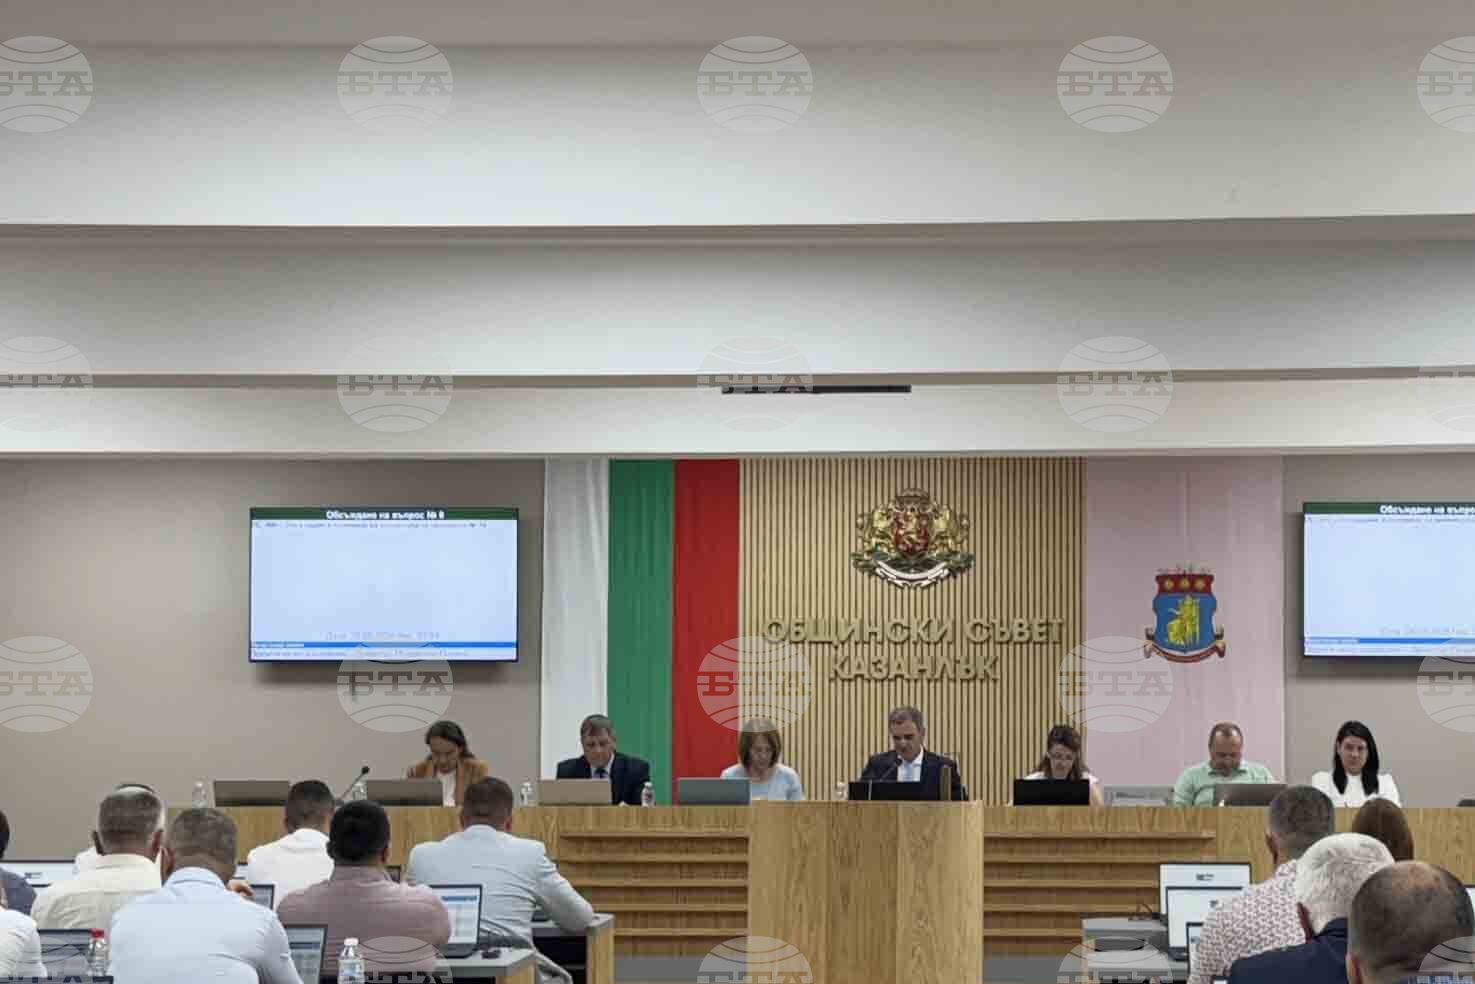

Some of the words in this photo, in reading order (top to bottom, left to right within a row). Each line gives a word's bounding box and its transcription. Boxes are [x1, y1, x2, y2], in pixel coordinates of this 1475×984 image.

[763, 617, 953, 650] ОБЩИНСКИ
[966, 617, 1065, 646] СЪВЕТ
[828, 655, 1000, 683] КАЗАНЛЪК
